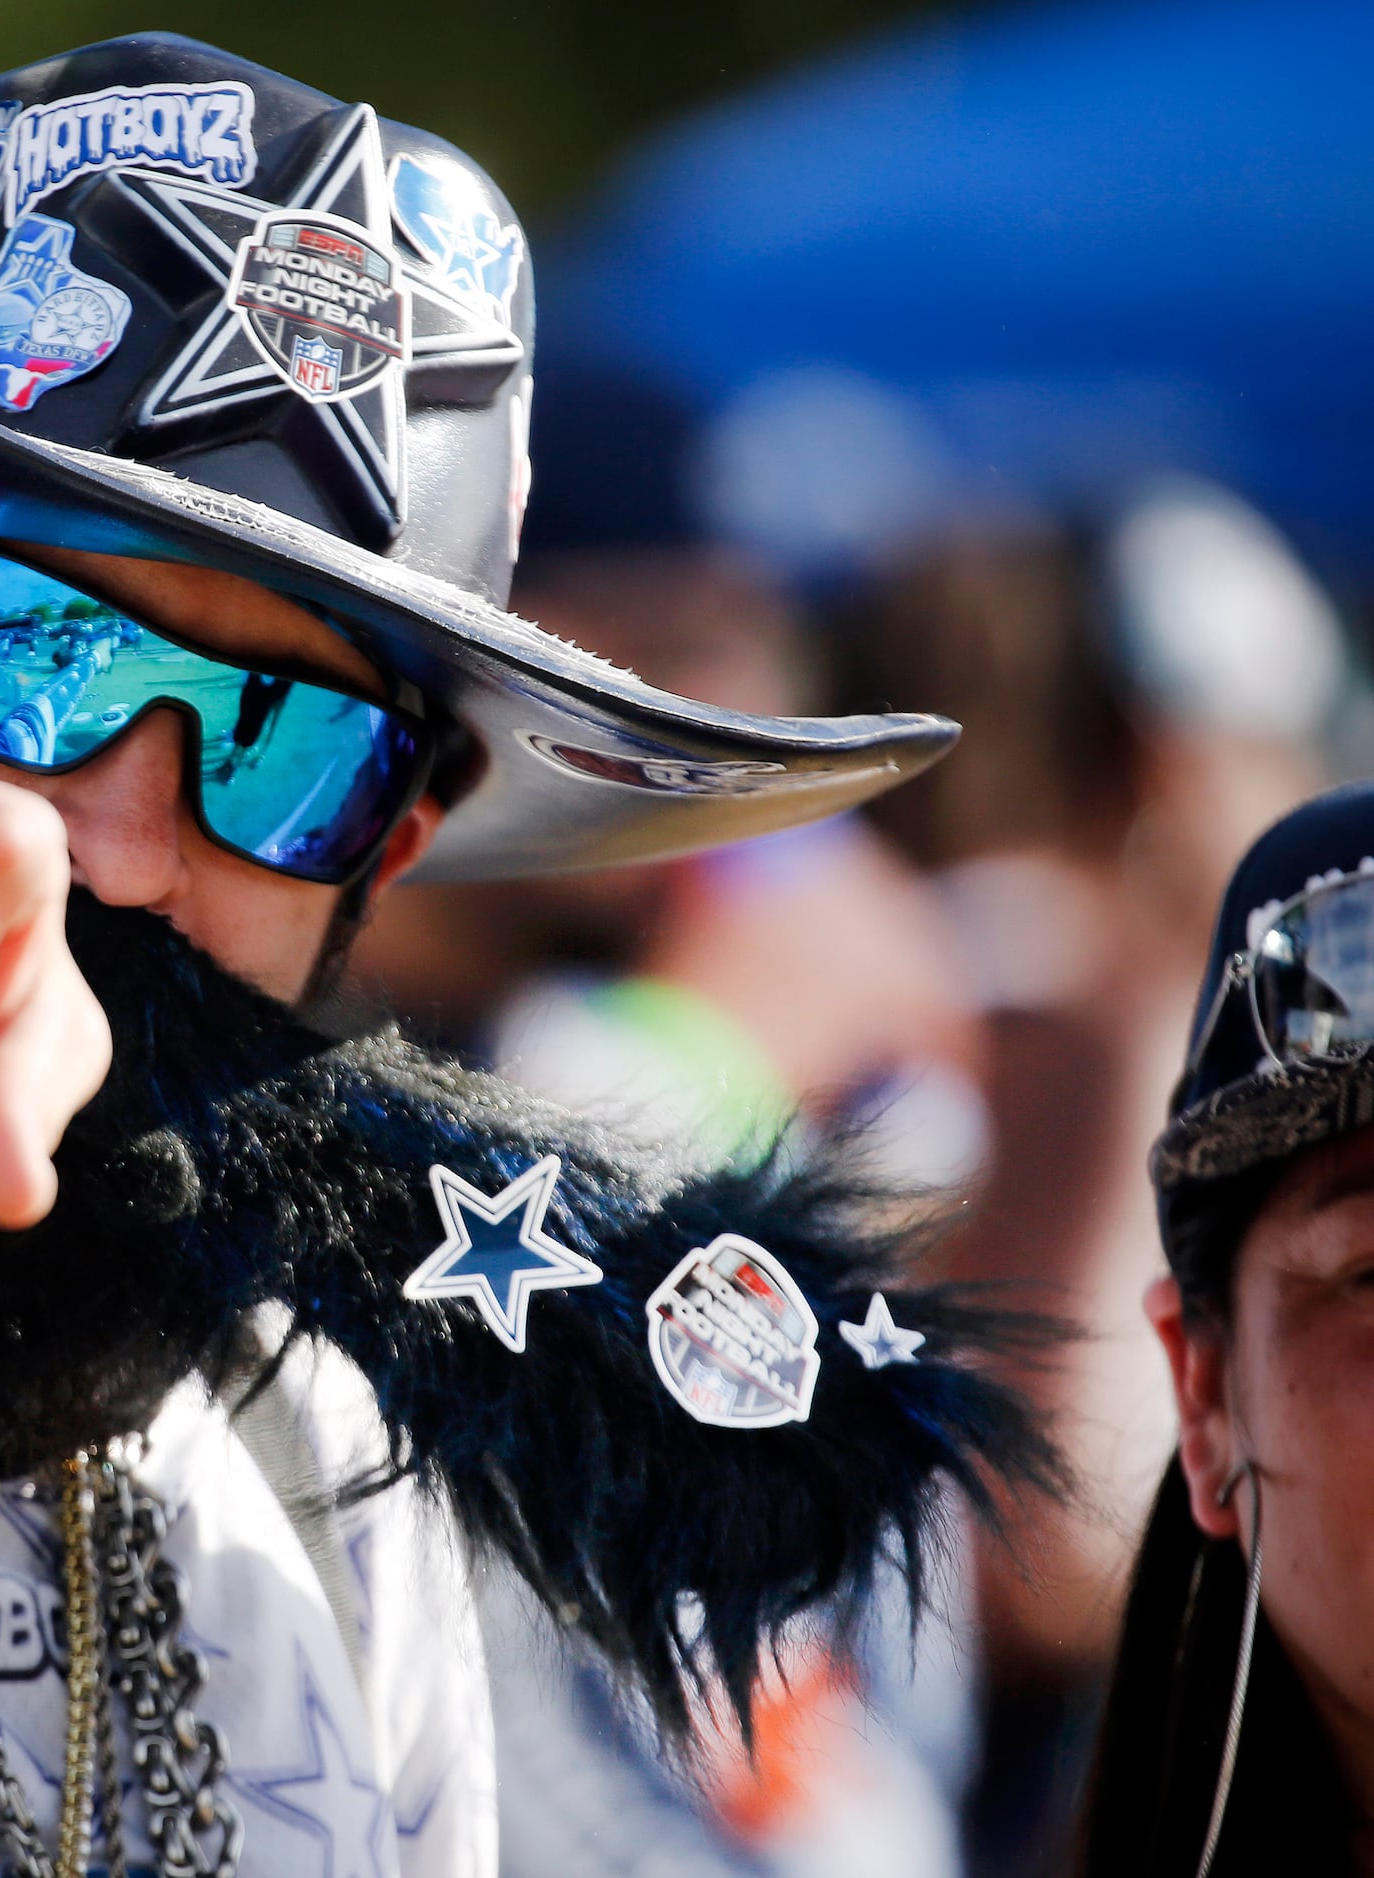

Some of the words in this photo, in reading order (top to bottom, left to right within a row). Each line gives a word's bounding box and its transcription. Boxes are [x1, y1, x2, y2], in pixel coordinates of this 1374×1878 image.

[17, 91, 246, 214] HOTBOYZ
[297, 229, 364, 265] ESPN
[254, 246, 395, 302] MONDAY
[273, 267, 377, 315] NIGHT
[237, 280, 403, 351] FOOTBALL
[21, 341, 60, 356] TEXAS
[63, 347, 90, 361] DFW
[296, 358, 334, 391] NFL
